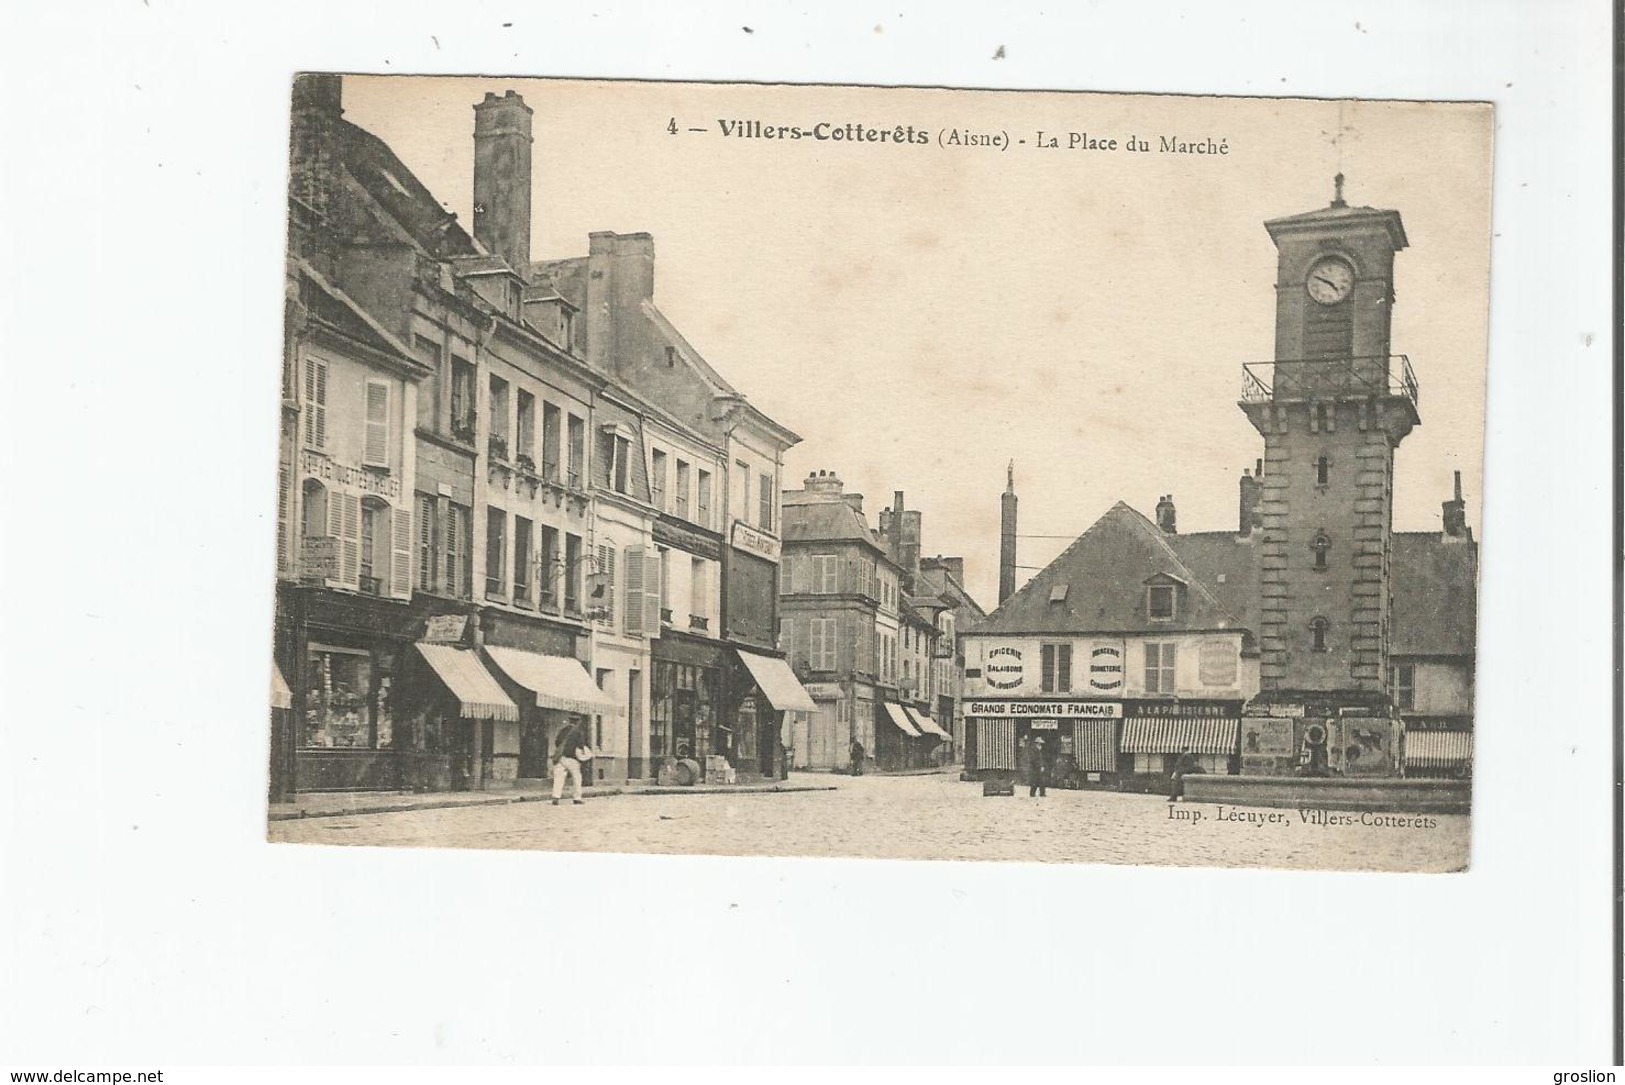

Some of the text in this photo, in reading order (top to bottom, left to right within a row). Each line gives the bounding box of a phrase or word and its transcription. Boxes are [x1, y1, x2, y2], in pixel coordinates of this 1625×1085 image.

[987, 664, 1023, 673] SALAISONS
[971, 702, 1006, 714] GRANDS
[1010, 703, 1063, 714] ECONOMATS
